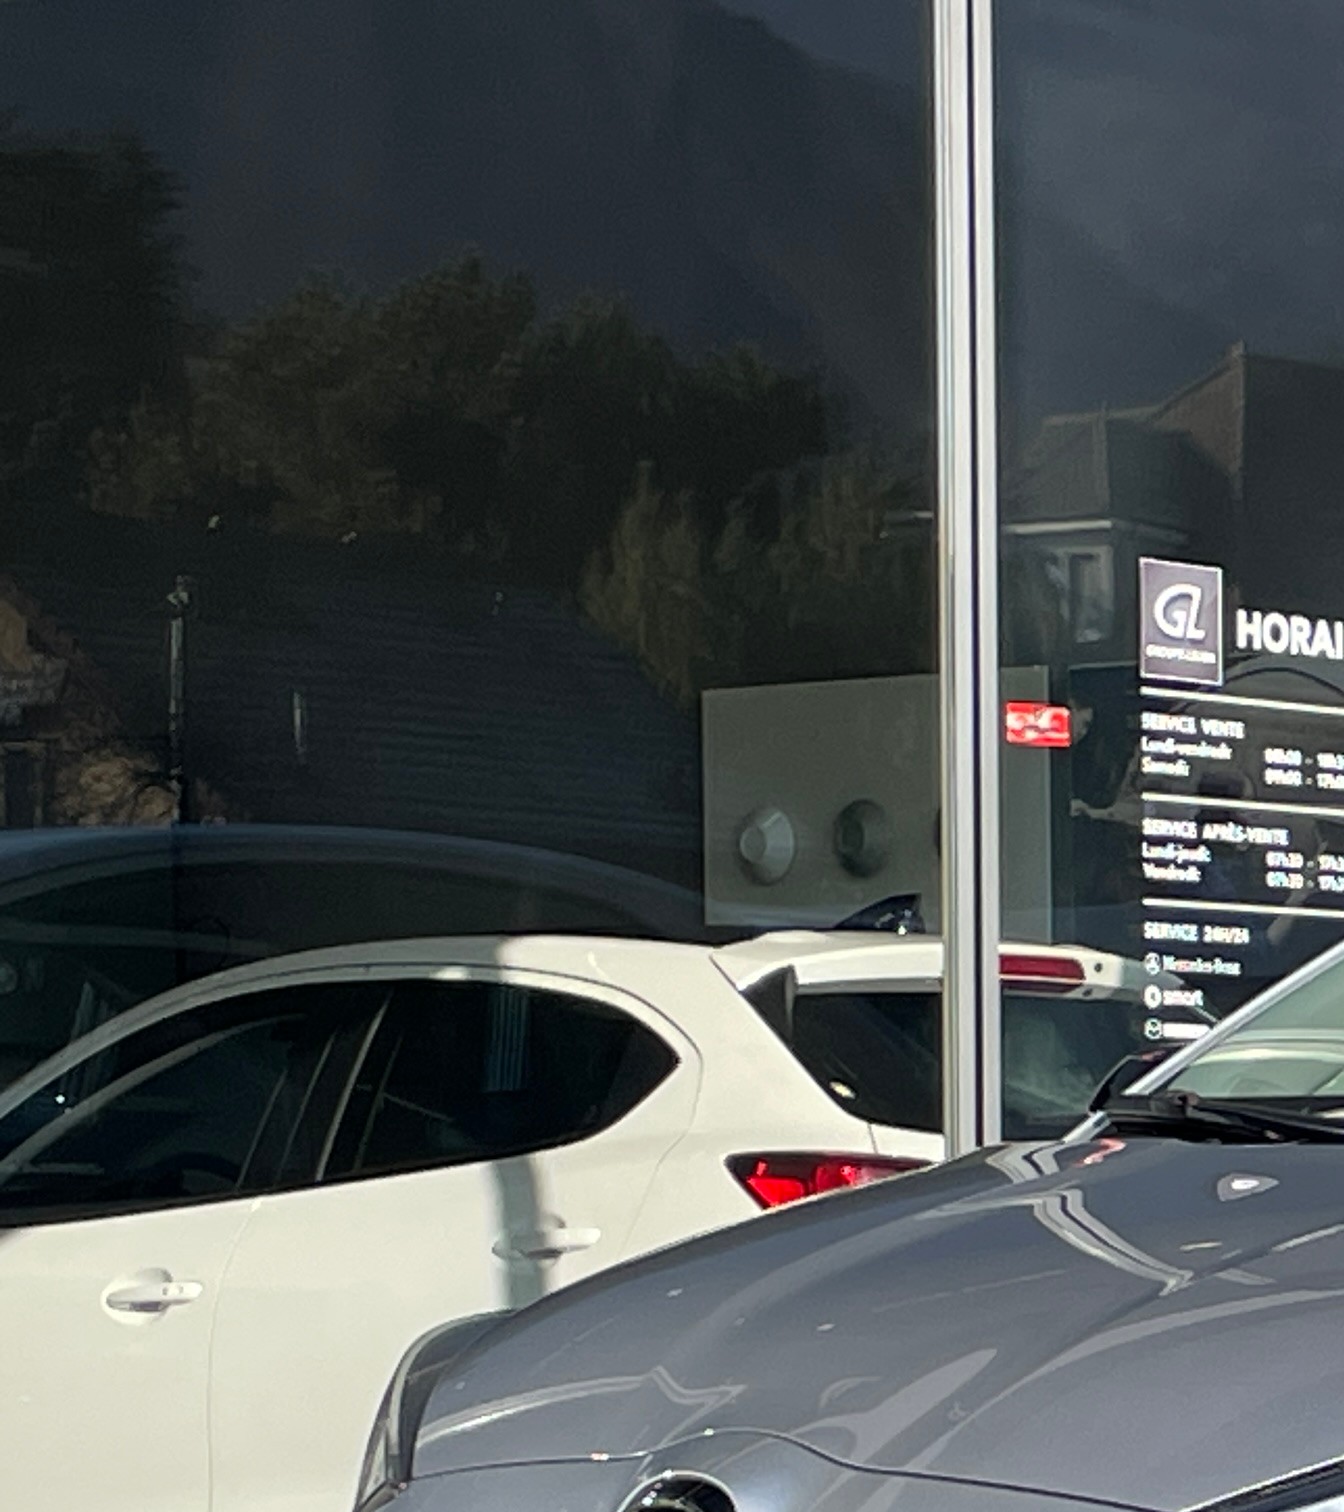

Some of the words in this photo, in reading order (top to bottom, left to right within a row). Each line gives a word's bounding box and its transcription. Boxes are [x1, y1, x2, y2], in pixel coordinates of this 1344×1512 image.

[1153, 583, 1206, 641] GL
[1141, 711, 1197, 735] SERVICE
[1200, 718, 1245, 740] VENTE
[1142, 817, 1198, 839] SERVICE
[1202, 821, 1289, 846] APRÈS-VENTE
[1143, 921, 1199, 942] SERVICE
[1162, 989, 1204, 1007] smart
